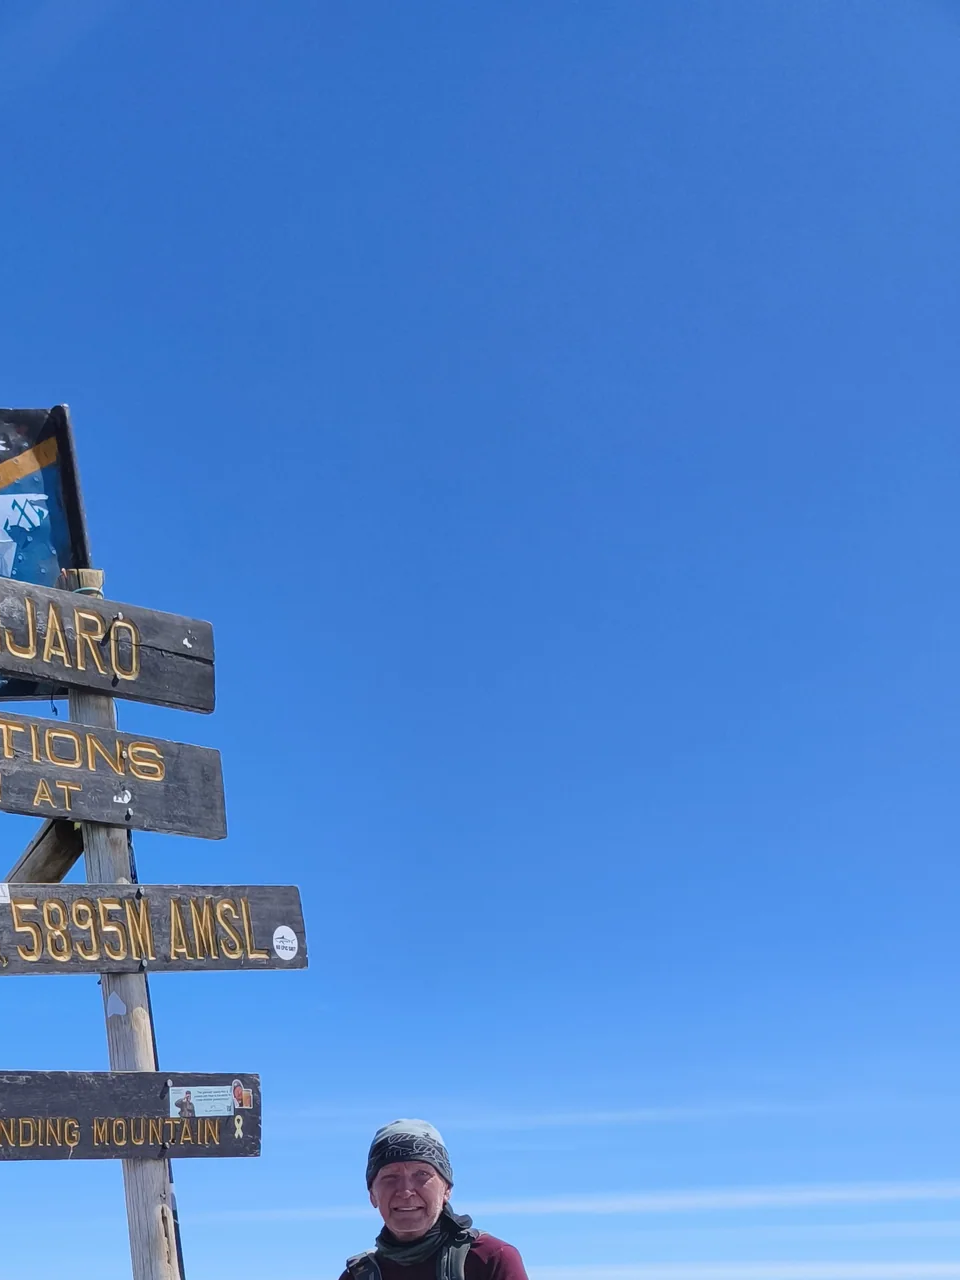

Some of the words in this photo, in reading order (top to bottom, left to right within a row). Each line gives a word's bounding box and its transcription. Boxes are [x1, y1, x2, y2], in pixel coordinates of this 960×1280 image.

[33, 779, 83, 811] AT
[12, 897, 158, 963] 5895M
[169, 896, 271, 961] AMSL
[93, 1115, 221, 1148] MOUNTAIN
